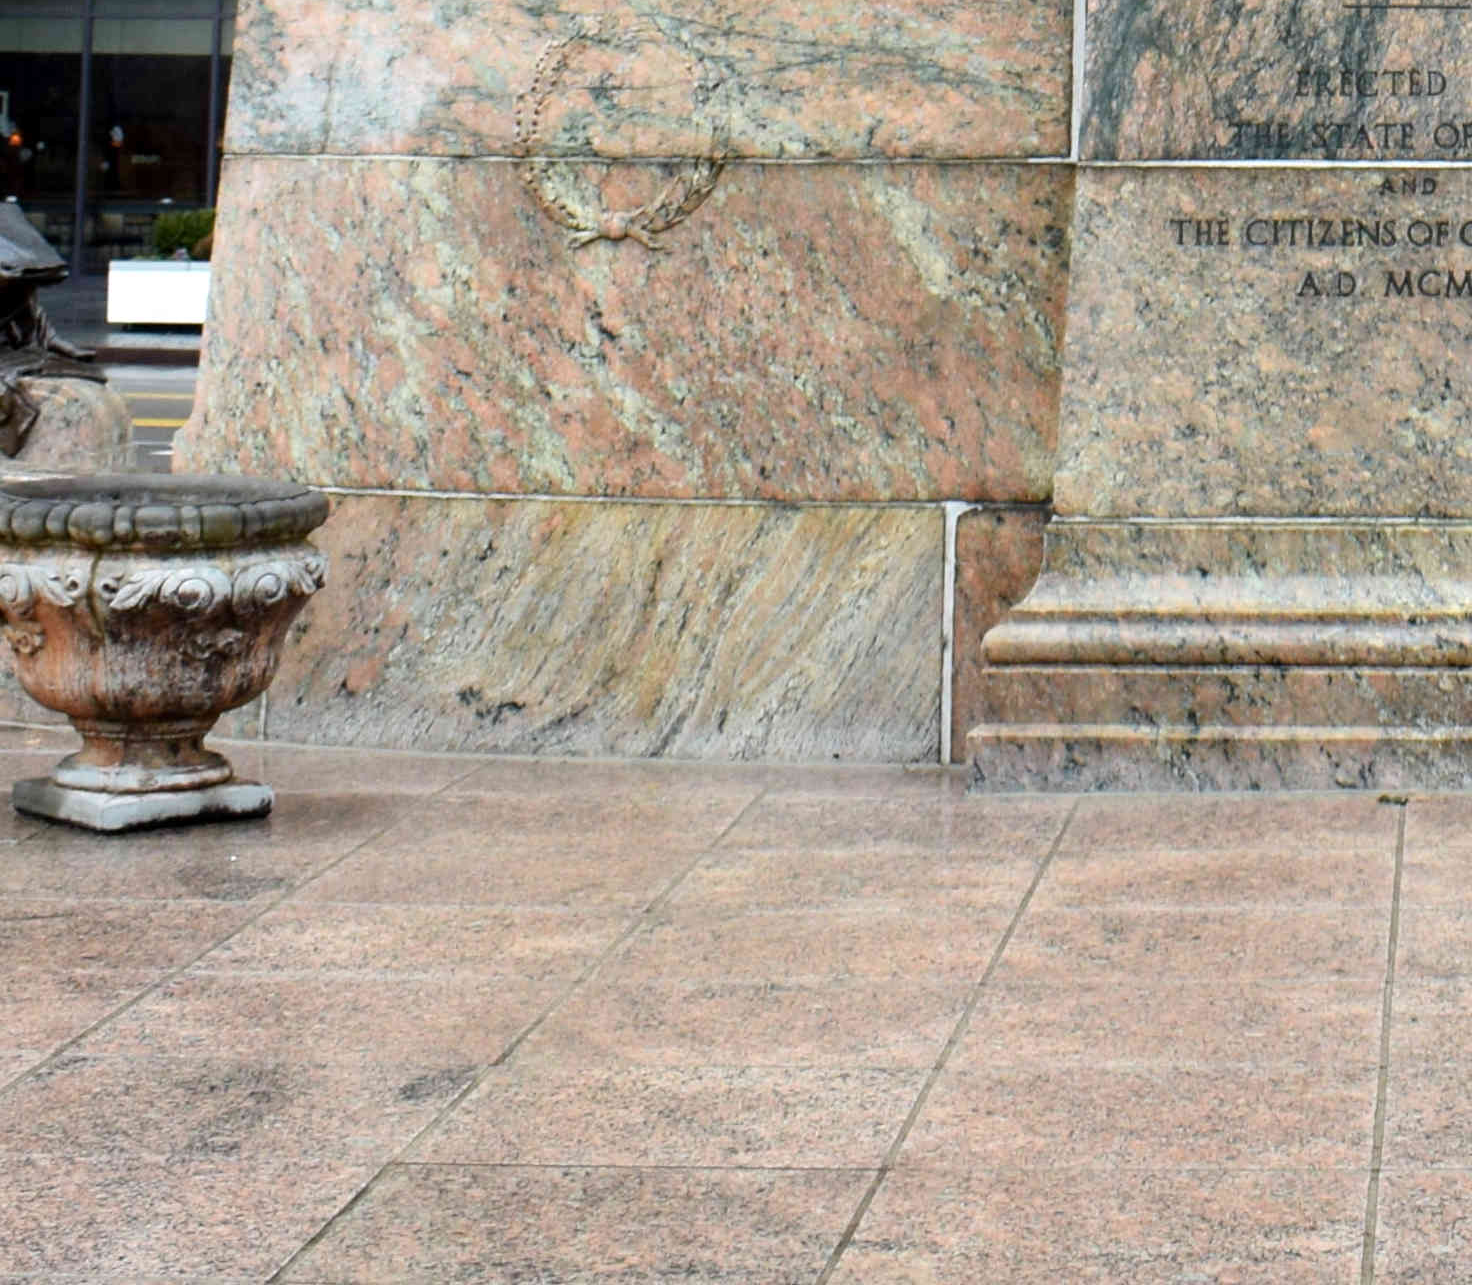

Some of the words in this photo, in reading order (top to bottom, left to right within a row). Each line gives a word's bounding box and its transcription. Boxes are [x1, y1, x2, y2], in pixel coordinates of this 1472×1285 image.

[1296, 70, 1447, 97] ERECTED
[1230, 122, 1290, 149] THE
[1311, 122, 1415, 149] STATE
[1380, 177, 1437, 196] AND
[1168, 219, 1229, 247] THE
[1246, 219, 1397, 247] CITIZENS
[1407, 220, 1449, 247] OF
